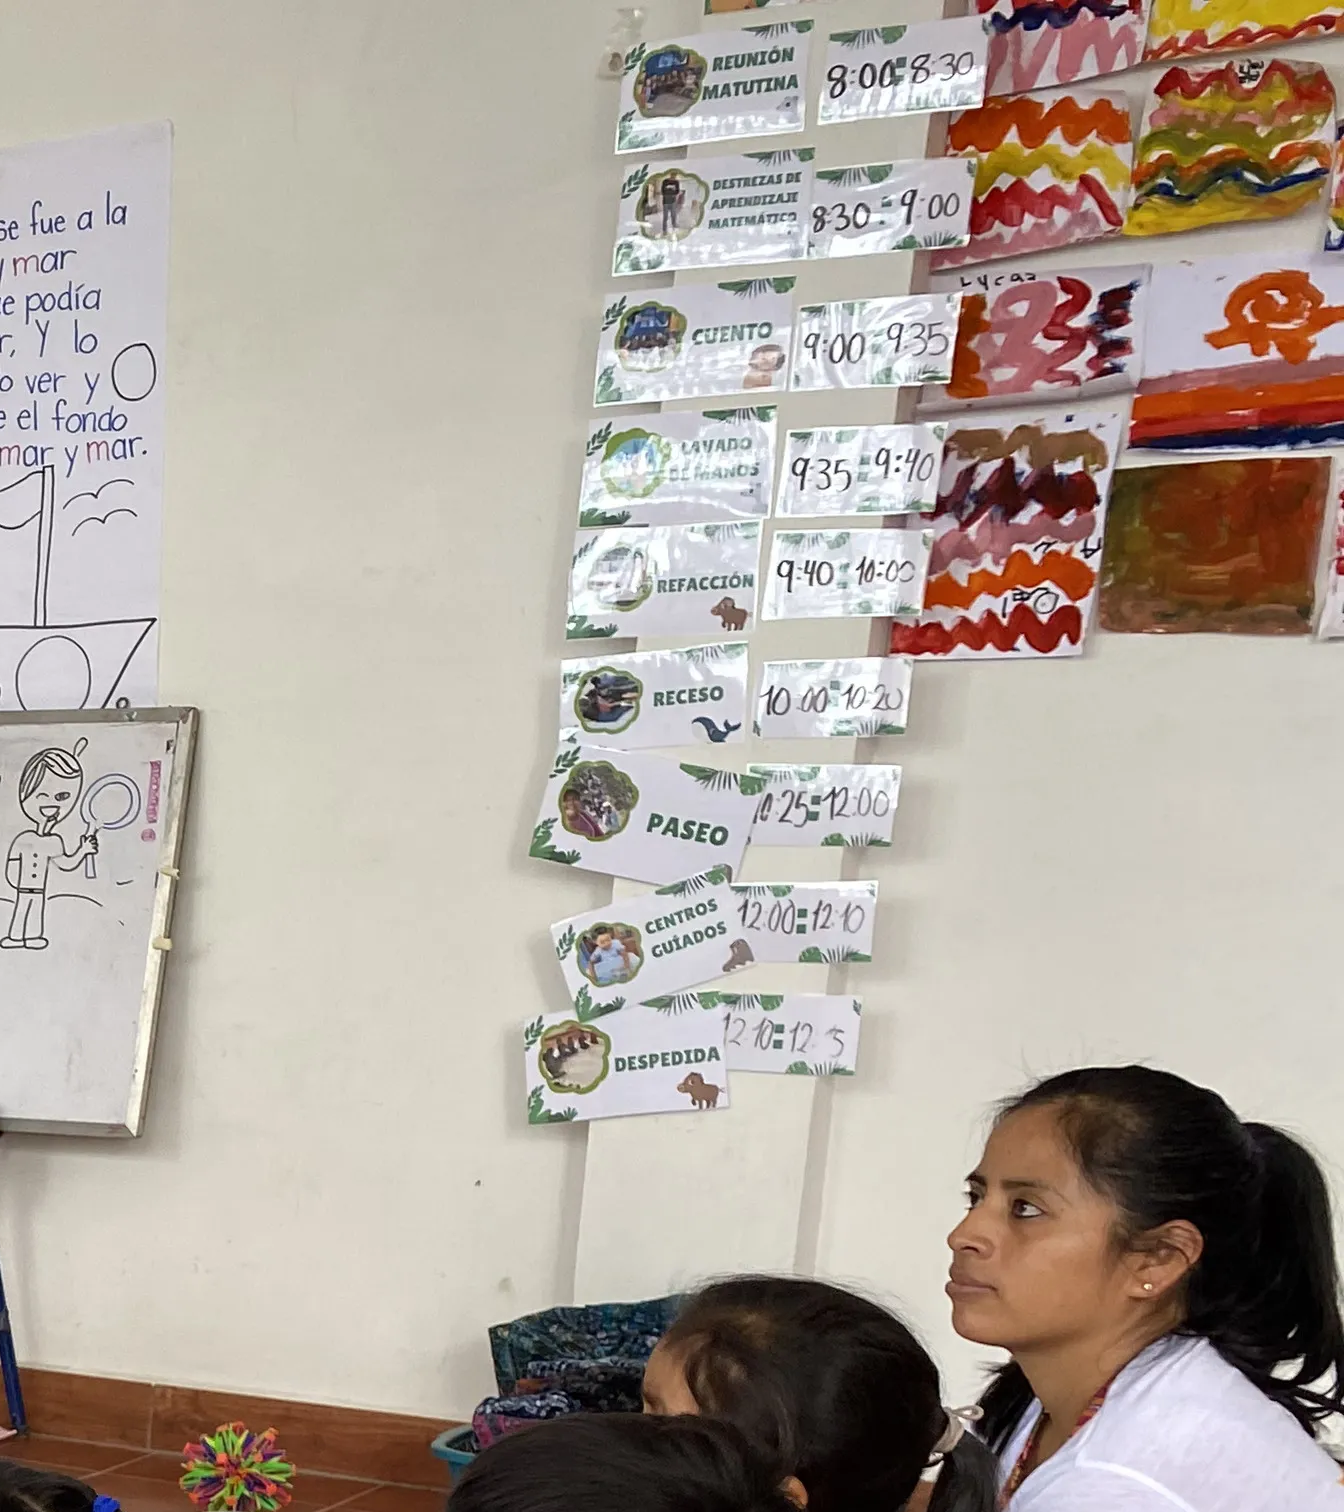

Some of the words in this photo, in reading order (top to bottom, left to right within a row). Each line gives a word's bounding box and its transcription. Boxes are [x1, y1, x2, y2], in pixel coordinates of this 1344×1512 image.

[711, 45, 795, 73] REUNIÓN
[702, 73, 799, 101] MATUTINA
[713, 173, 783, 190] DESTREZAS
[785, 171, 802, 184] DE
[30, 200, 66, 236] fue
[77, 211, 93, 229] a
[105, 191, 127, 226] la
[710, 192, 799, 210] APRENDIZAJE
[708, 210, 797, 229] MATEMÁTICO
[13, 250, 77, 277] mar
[26, 280, 101, 325] podía
[75, 319, 97, 353] lo
[692, 321, 772, 346] CUENTO
[25, 372, 66, 394] ver
[84, 373, 100, 405] y
[17, 400, 38, 431] el
[52, 399, 128, 433] fondo
[65, 445, 78, 478] y
[87, 436, 148, 464] mar.
[681, 436, 753, 454] LAVADO
[668, 464, 691, 482] DE
[694, 461, 760, 482] MANOS
[875, 447, 935, 483] 9:40
[656, 571, 755, 594] REFACCIÓN
[777, 559, 835, 593] 9:40
[653, 685, 724, 708] RECESO
[646, 812, 729, 847] PASEO
[644, 898, 719, 935] CENTROS
[651, 921, 728, 959] GUÍADOS
[614, 1046, 721, 1073] DESPEDIDA
